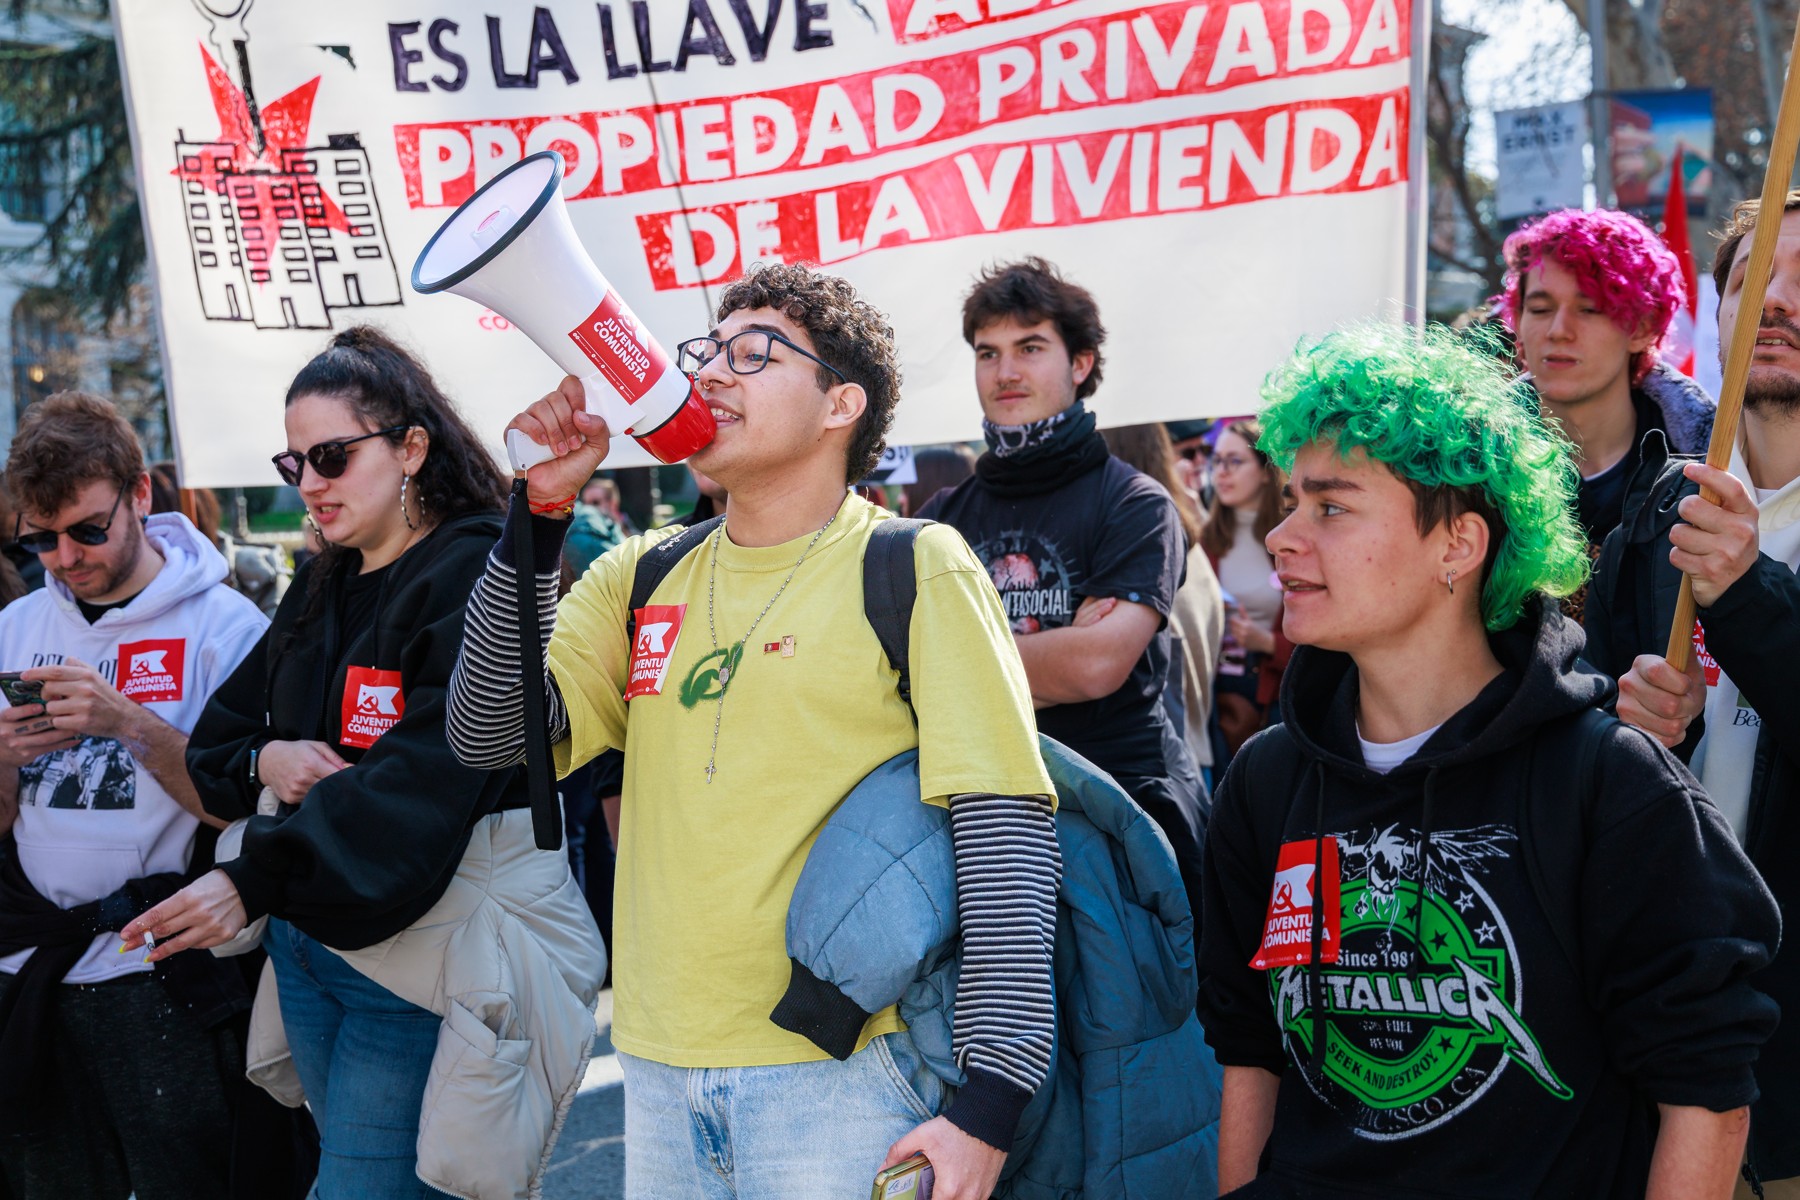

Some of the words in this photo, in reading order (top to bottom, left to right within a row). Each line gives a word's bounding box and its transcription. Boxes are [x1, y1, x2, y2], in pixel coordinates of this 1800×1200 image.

[388, 18, 468, 93] ES
[485, 6, 580, 89] LA
[598, 0, 834, 80] LLAVE
[418, 73, 946, 206] PROPIEDAD
[978, 0, 1399, 123] PRIVADA
[670, 200, 785, 286] DE
[815, 175, 931, 264] LA
[955, 98, 1399, 231] VIVIENDA
[593, 321, 648, 383] COMUNISTA
[603, 317, 651, 370] JUVENTUD
[121, 682, 177, 696] COMUNISTA
[125, 675, 173, 688] JUVENTUD
[350, 714, 401, 728] JUVENTU
[1264, 927, 1331, 949] COMUNISA
[1267, 913, 1325, 934] JUVENTU
[1335, 948, 1378, 968] Since
[1327, 1042, 1362, 1077] SEEK
[1363, 1068, 1385, 1090] AND
[1386, 1048, 1439, 1090] DESTROY
